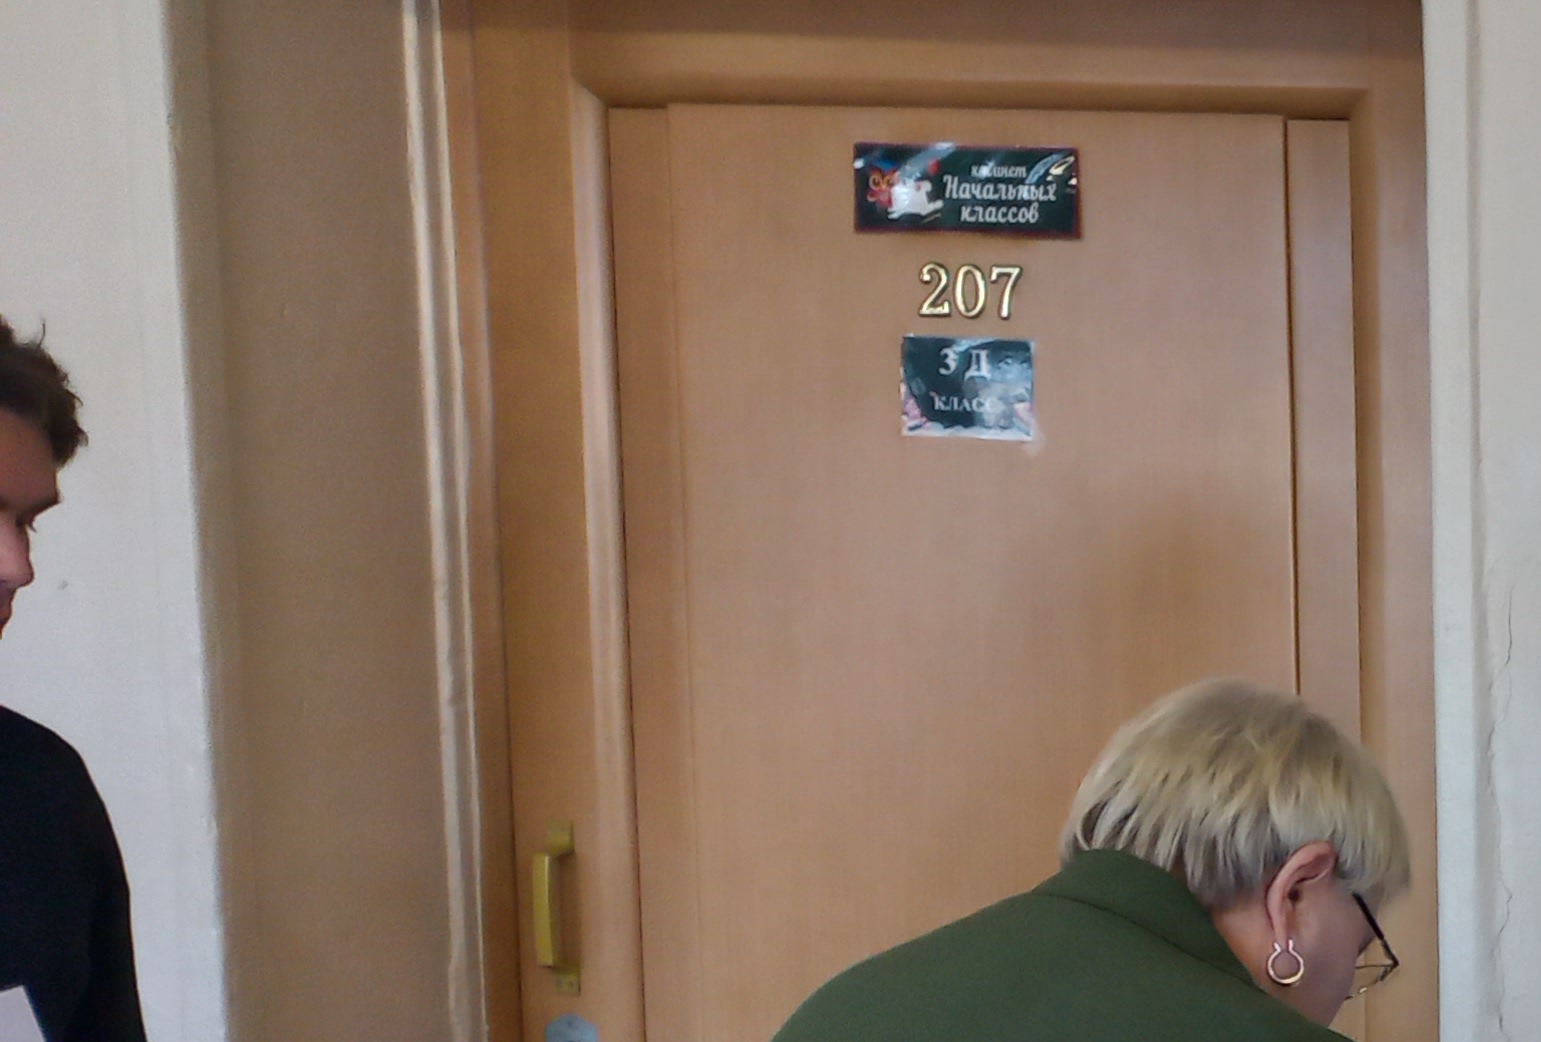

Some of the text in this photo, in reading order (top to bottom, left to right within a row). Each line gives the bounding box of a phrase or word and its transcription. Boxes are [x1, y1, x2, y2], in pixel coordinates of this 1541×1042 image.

[943, 174, 1057, 201] Начальных
[960, 201, 1040, 223] классов
[918, 261, 1023, 320] 207
[963, 348, 991, 382] Д
